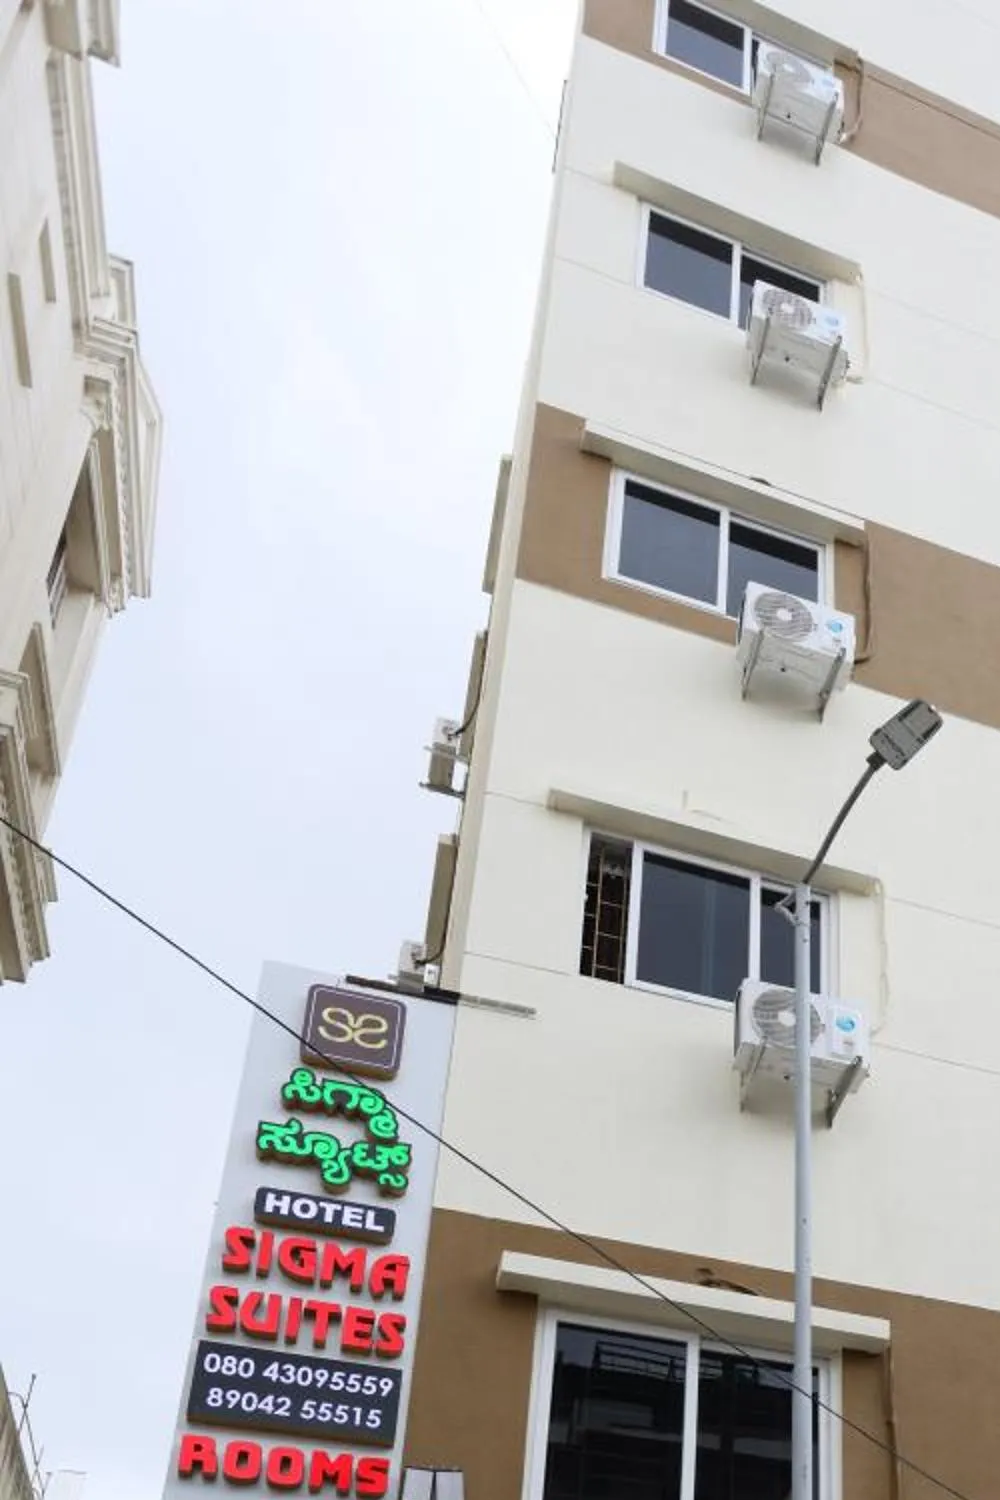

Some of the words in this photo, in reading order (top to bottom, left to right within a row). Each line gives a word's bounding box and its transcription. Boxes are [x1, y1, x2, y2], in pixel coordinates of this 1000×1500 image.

[263, 1191, 385, 1233] HOTEL
[222, 1226, 410, 1297] SIGMA
[207, 1285, 406, 1353] SUITES
[203, 1352, 255, 1379] 080
[262, 1361, 394, 1398] 43095559
[205, 1387, 291, 1417] 89042
[300, 1400, 383, 1429] 55515
[178, 1434, 390, 1496] ROOMS
